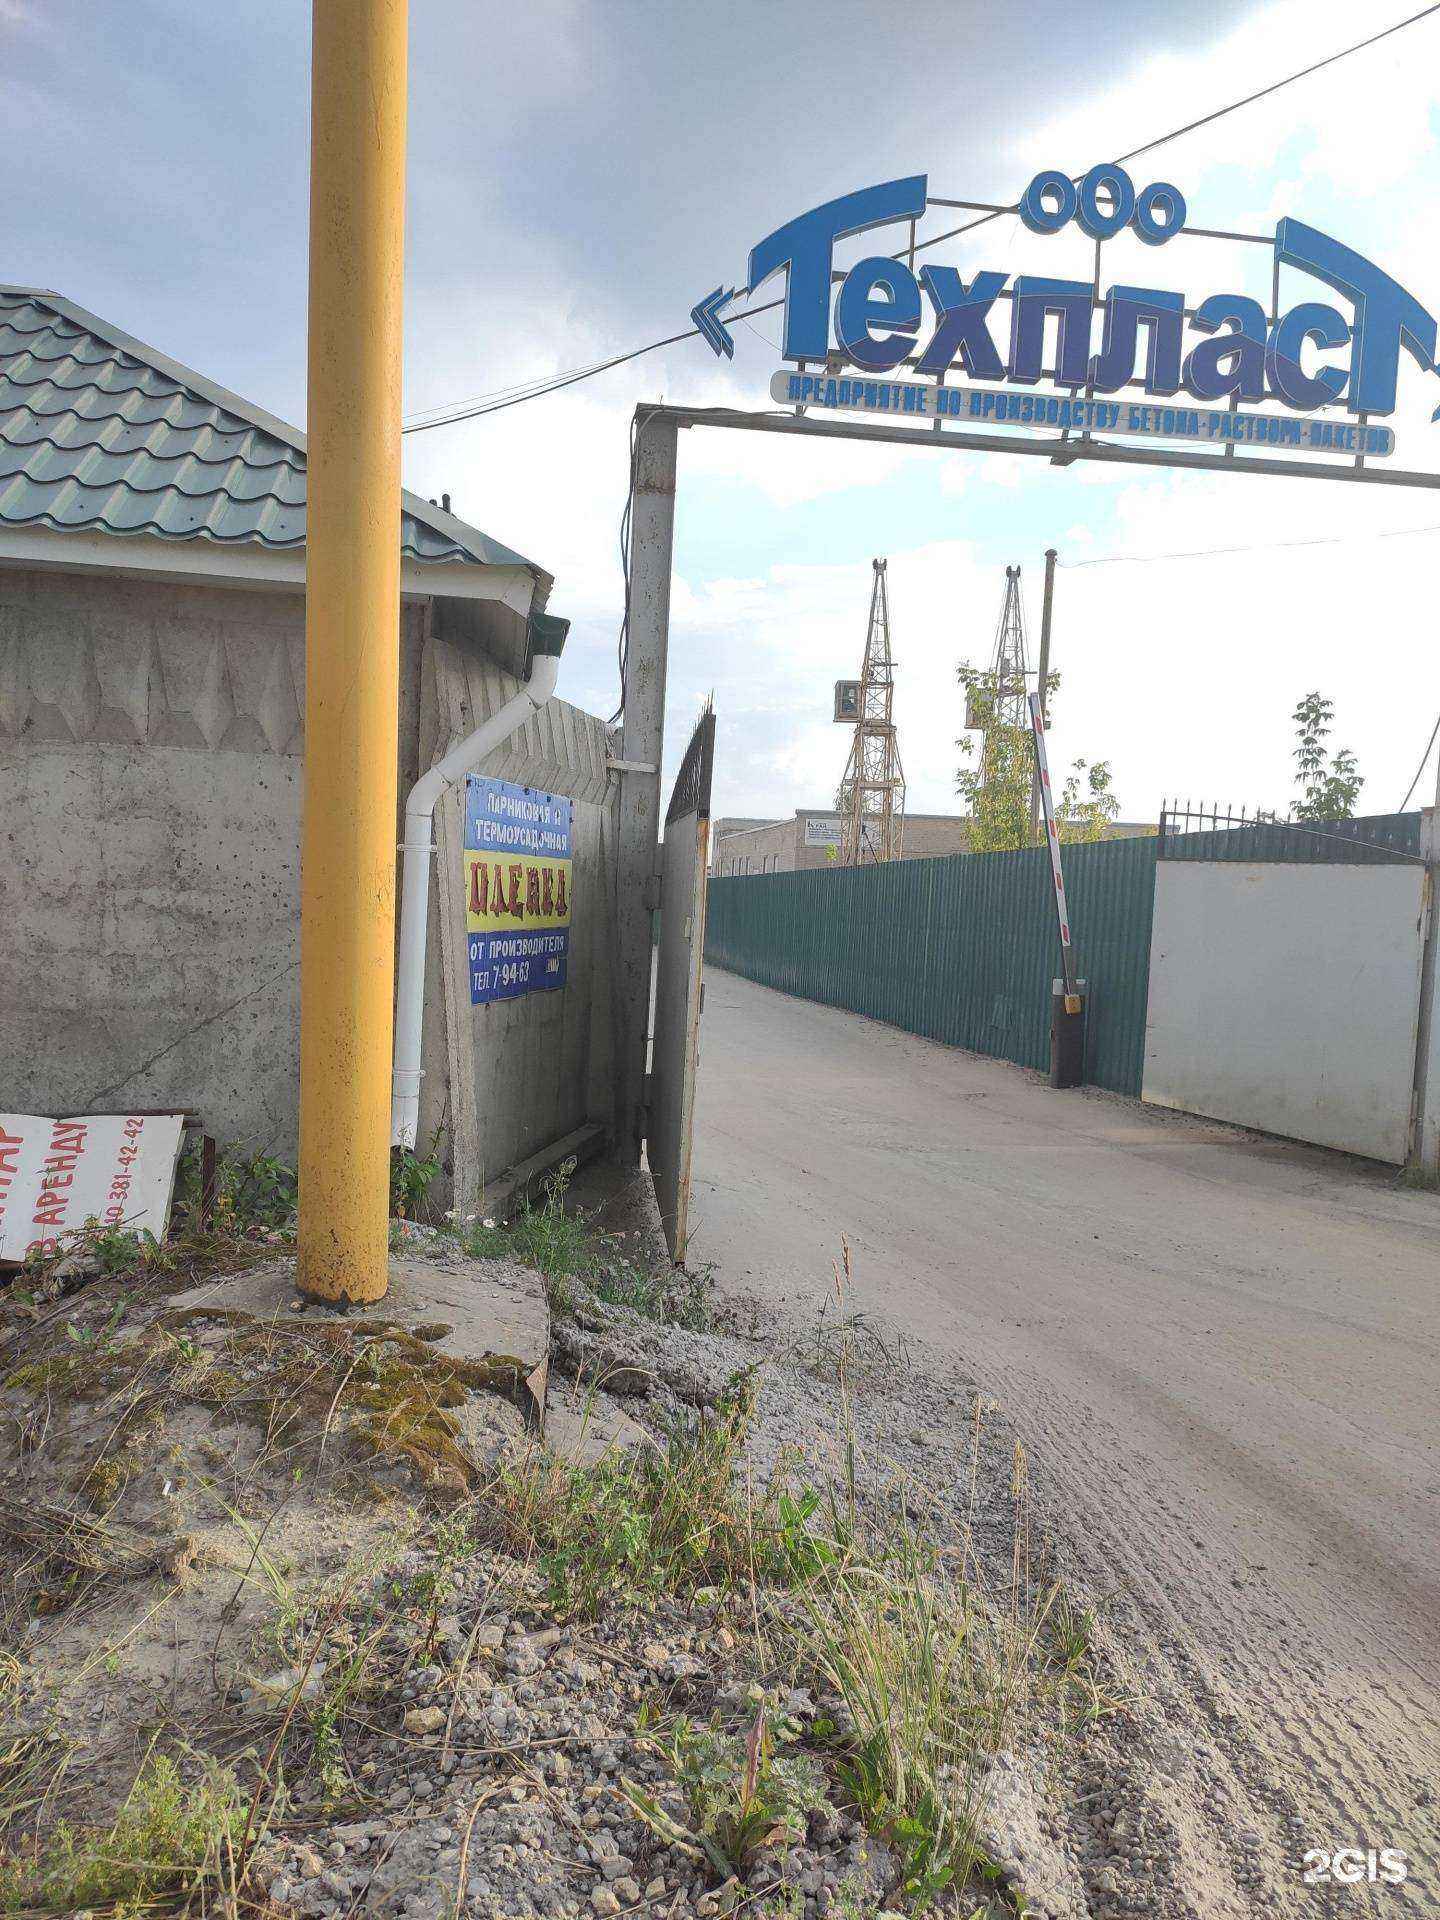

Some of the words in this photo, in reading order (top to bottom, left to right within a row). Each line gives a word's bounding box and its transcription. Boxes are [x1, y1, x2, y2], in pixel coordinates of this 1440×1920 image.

[788, 375, 928, 413] ПРЕДПРИЯТИЕ
[937, 388, 962, 416] ПО
[969, 392, 1120, 429] ПРОИЗВОДСТВУ
[1128, 406, 1199, 435] БЕТОНА
[487, 792, 551, 824] ПАРНИКОВАЯ
[475, 819, 567, 851] ТЕРМОУСАДОЧНАЯ
[470, 941, 485, 961] ОТ
[489, 935, 565, 959] ПРОИЗВОДИТЕЛЯ
[492, 960, 530, 989] 7-94-63
[32, 1121, 88, 1226] АРЕНДУ
[108, 1118, 145, 1201] 381-42-42
